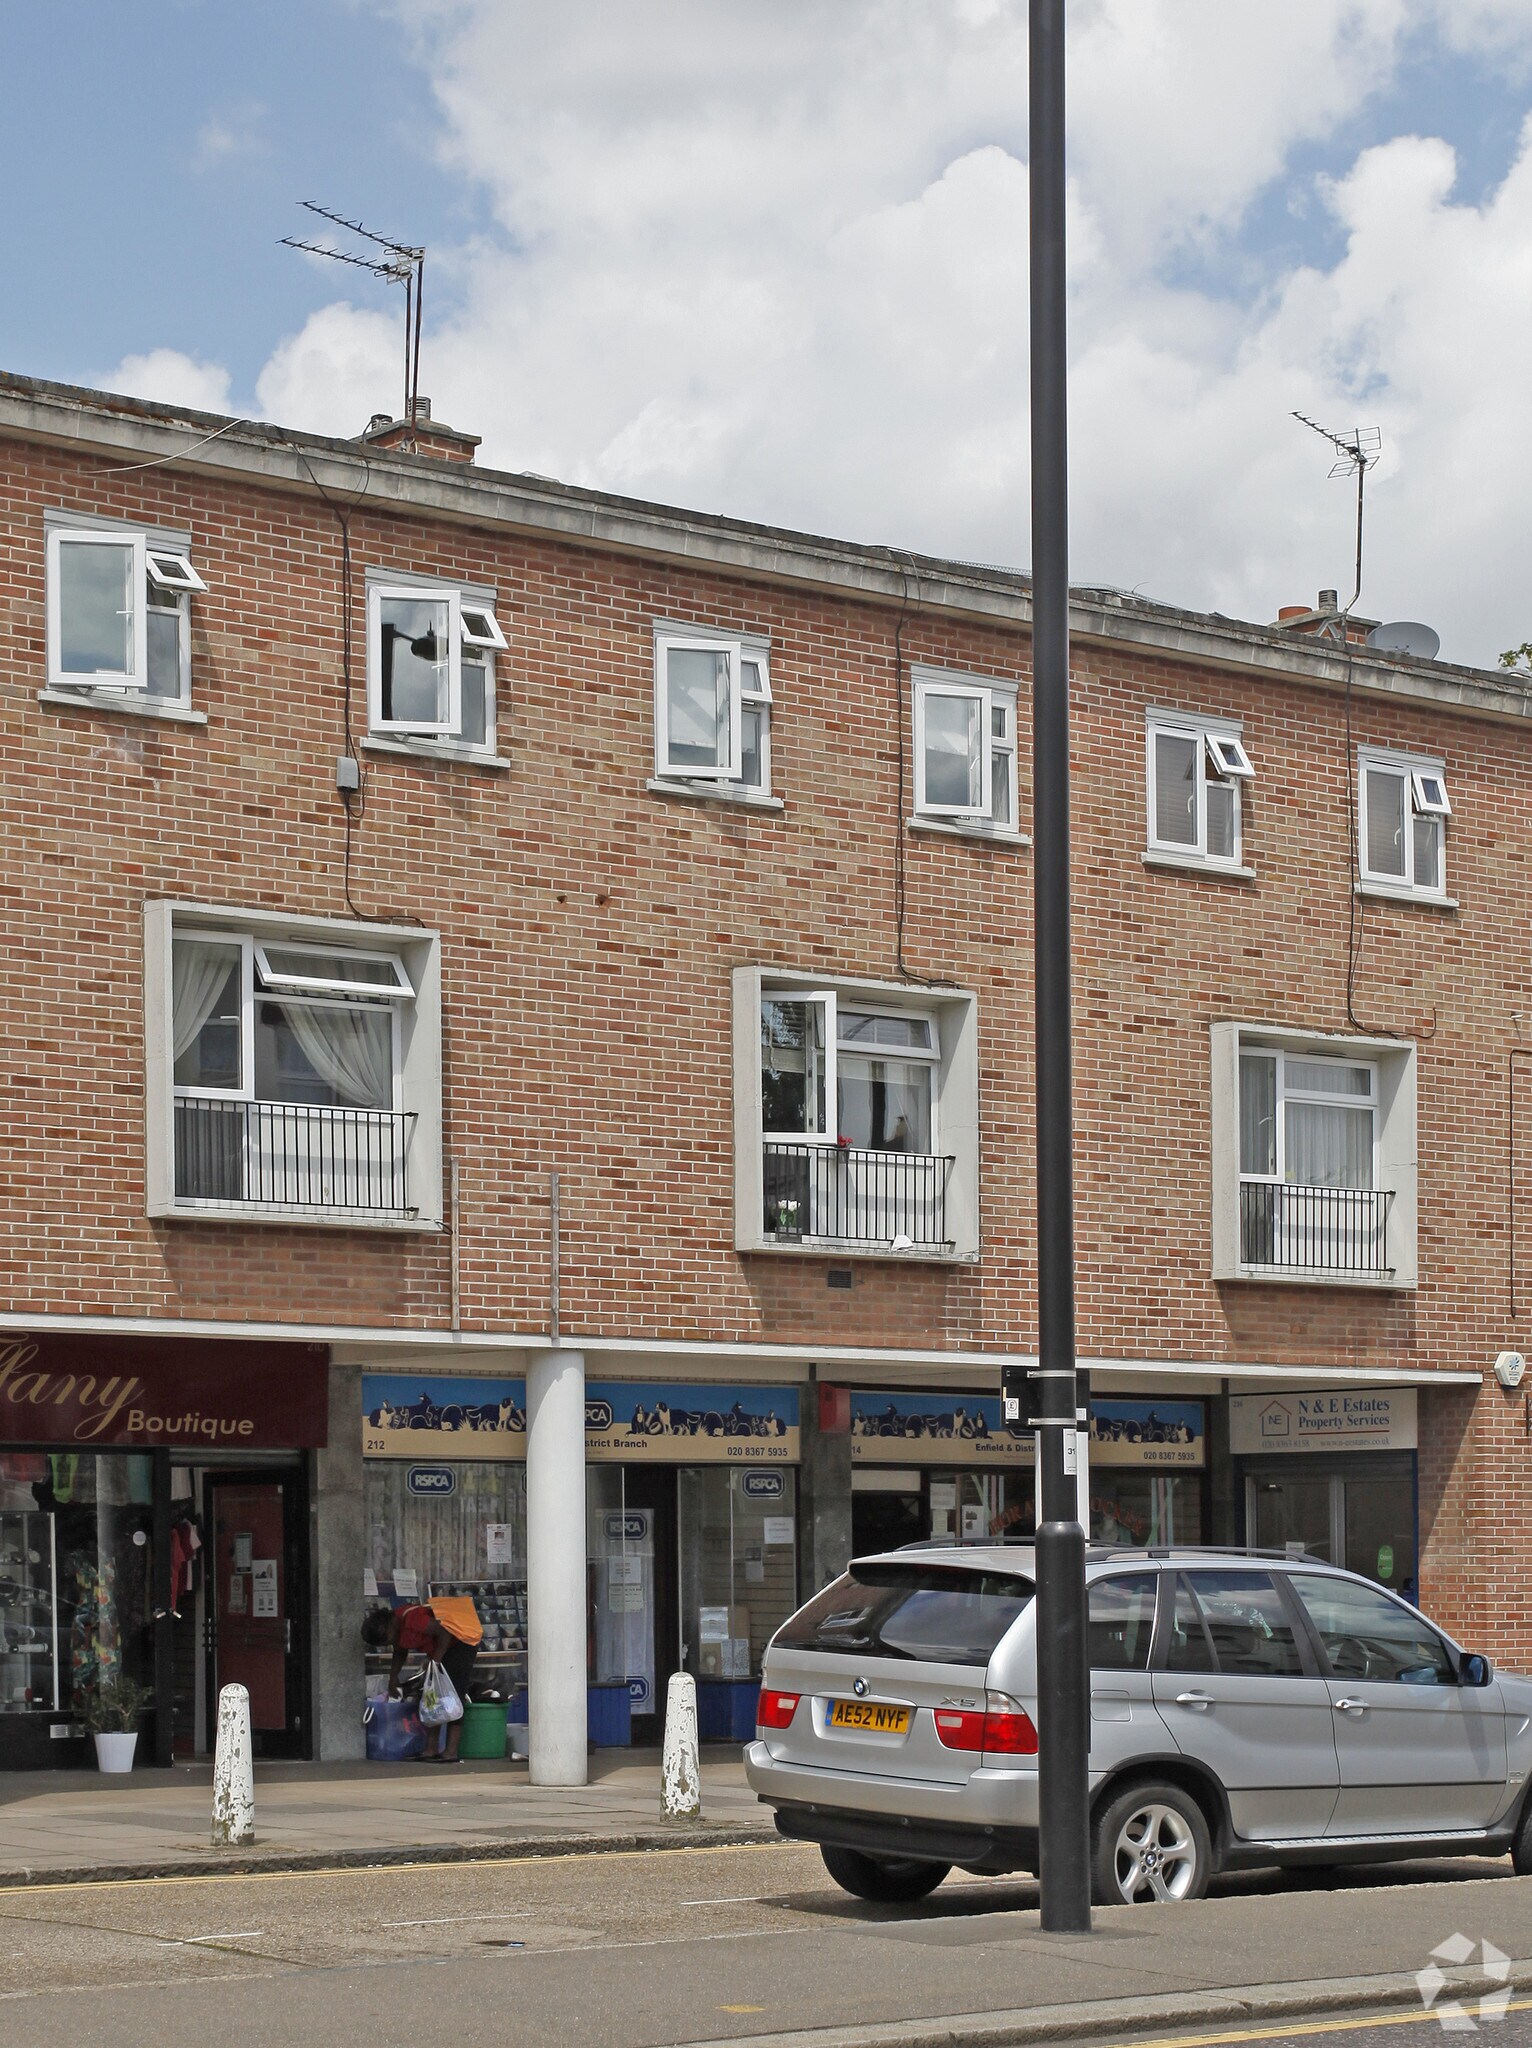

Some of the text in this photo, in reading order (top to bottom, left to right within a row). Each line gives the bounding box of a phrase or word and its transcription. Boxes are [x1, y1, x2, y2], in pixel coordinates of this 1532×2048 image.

[1299, 1398, 1390, 1414] N & E Estates
[585, 1408, 608, 1422] PCA
[1268, 1415, 1282, 1425] NE
[127, 1409, 254, 1439] Boutique
[1299, 1413, 1390, 1430] Property Services
[367, 1440, 385, 1449] 212
[585, 1438, 648, 1448] strict Branch
[975, 1443, 1036, 1453] Enfield & Distr
[727, 1446, 788, 1457] 020 8367 5935
[851, 1446, 862, 1454] 14
[1143, 1451, 1195, 1461] 020 8367 5935
[414, 1474, 449, 1487] RSPCA
[749, 1478, 780, 1490] RSPCA
[939, 1696, 976, 1708] X5
[835, 1703, 907, 1729] AE52 NYF
